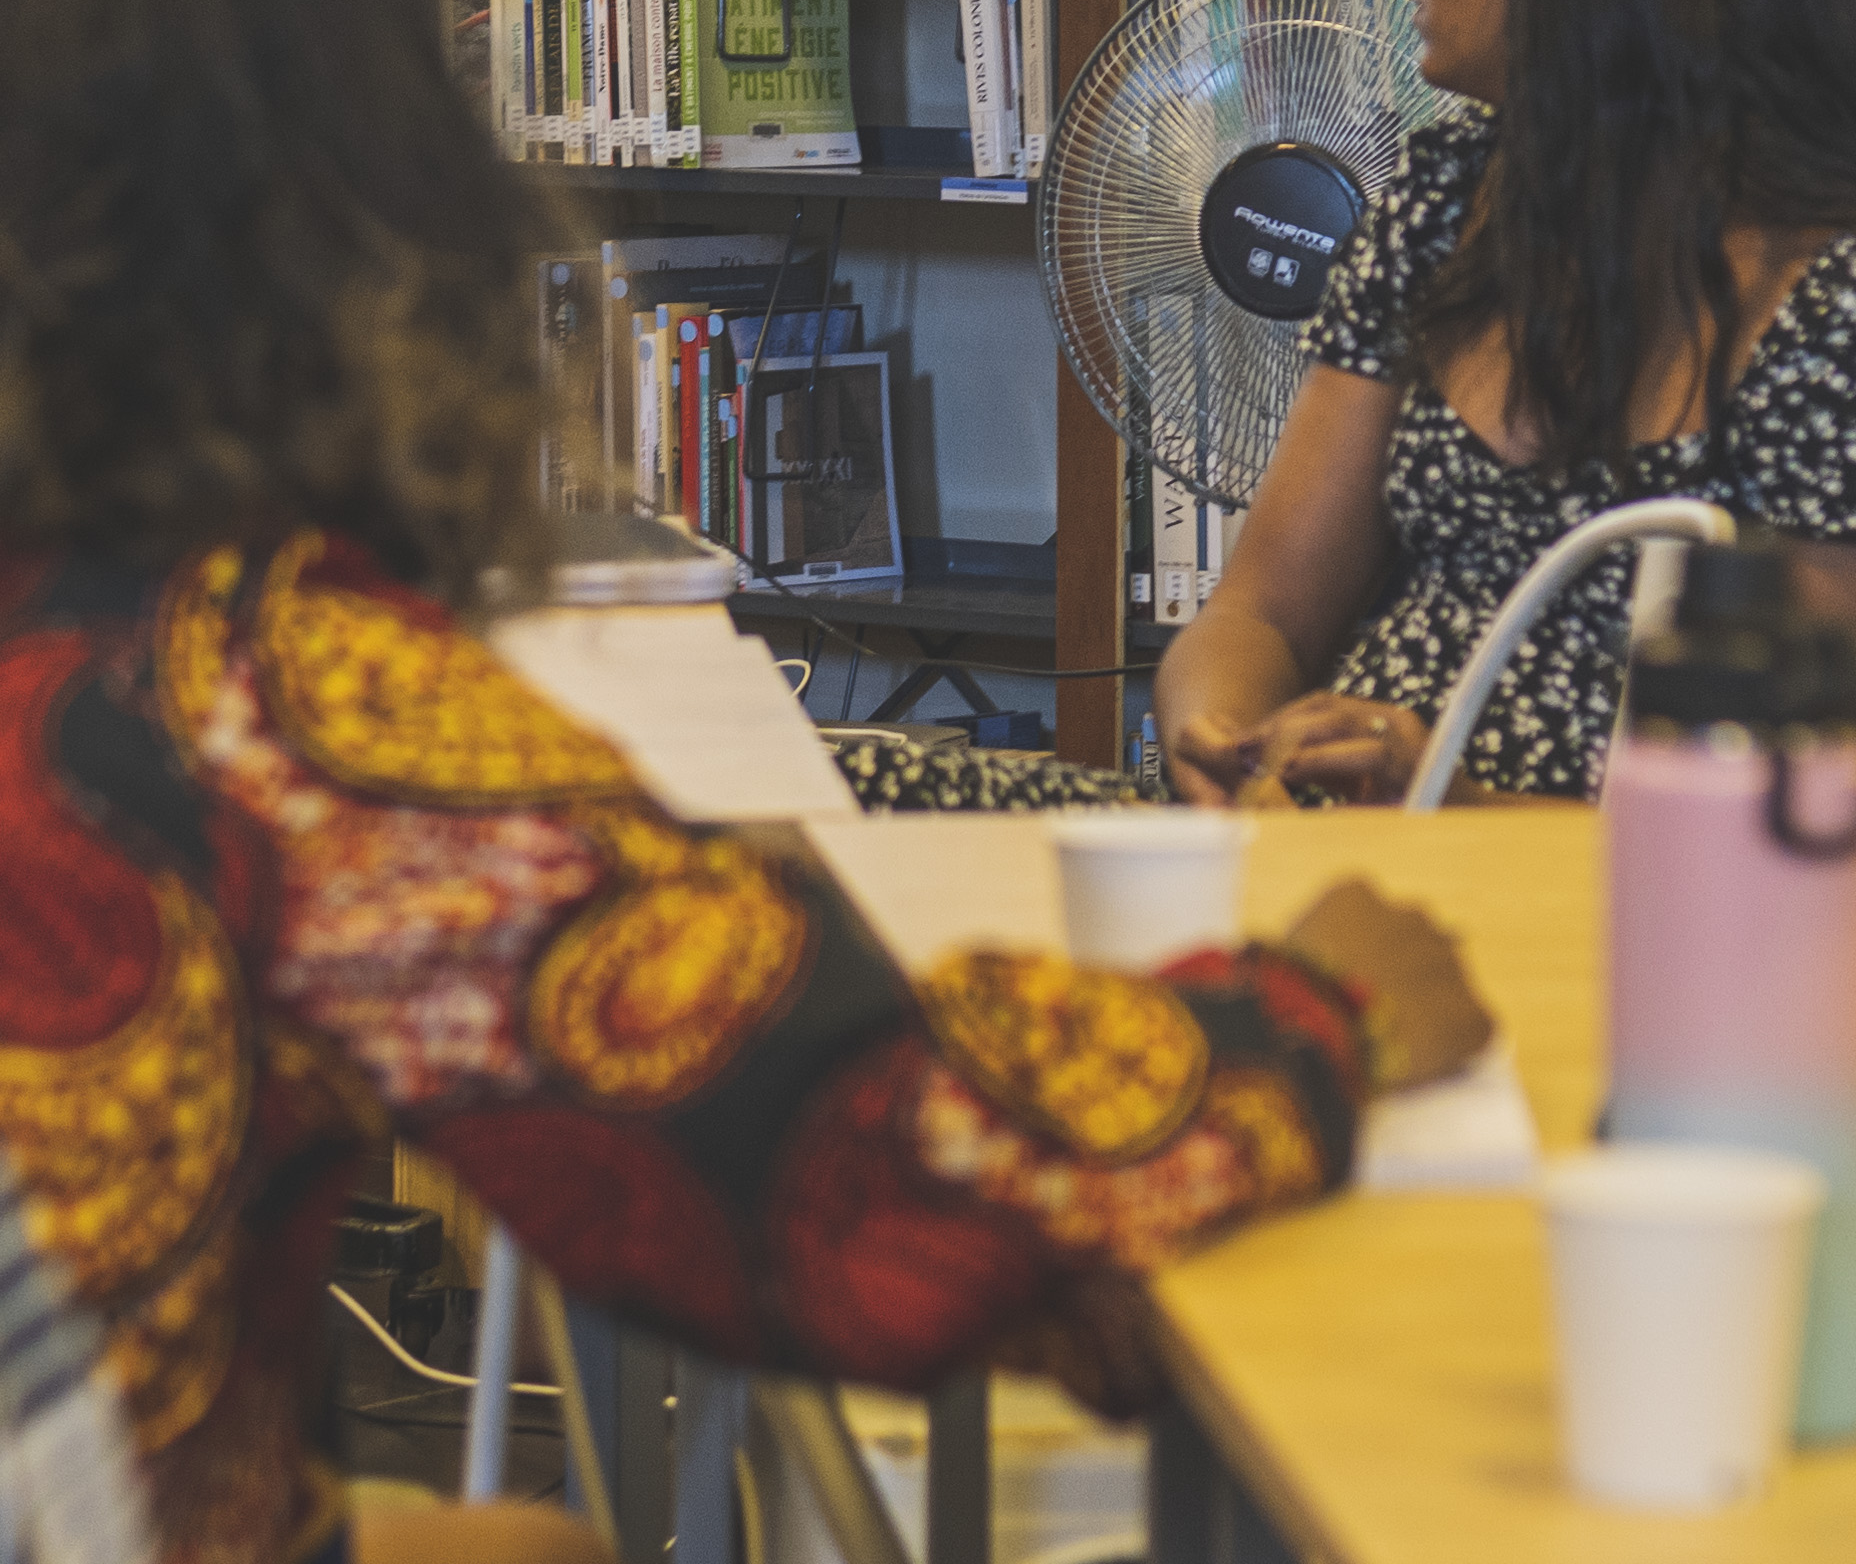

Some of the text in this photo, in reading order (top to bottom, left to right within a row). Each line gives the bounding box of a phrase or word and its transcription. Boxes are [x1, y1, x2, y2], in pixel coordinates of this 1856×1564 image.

[547, 3, 559, 29] DE
[651, 32, 662, 76] maison
[727, 68, 843, 101] POSITIVE
